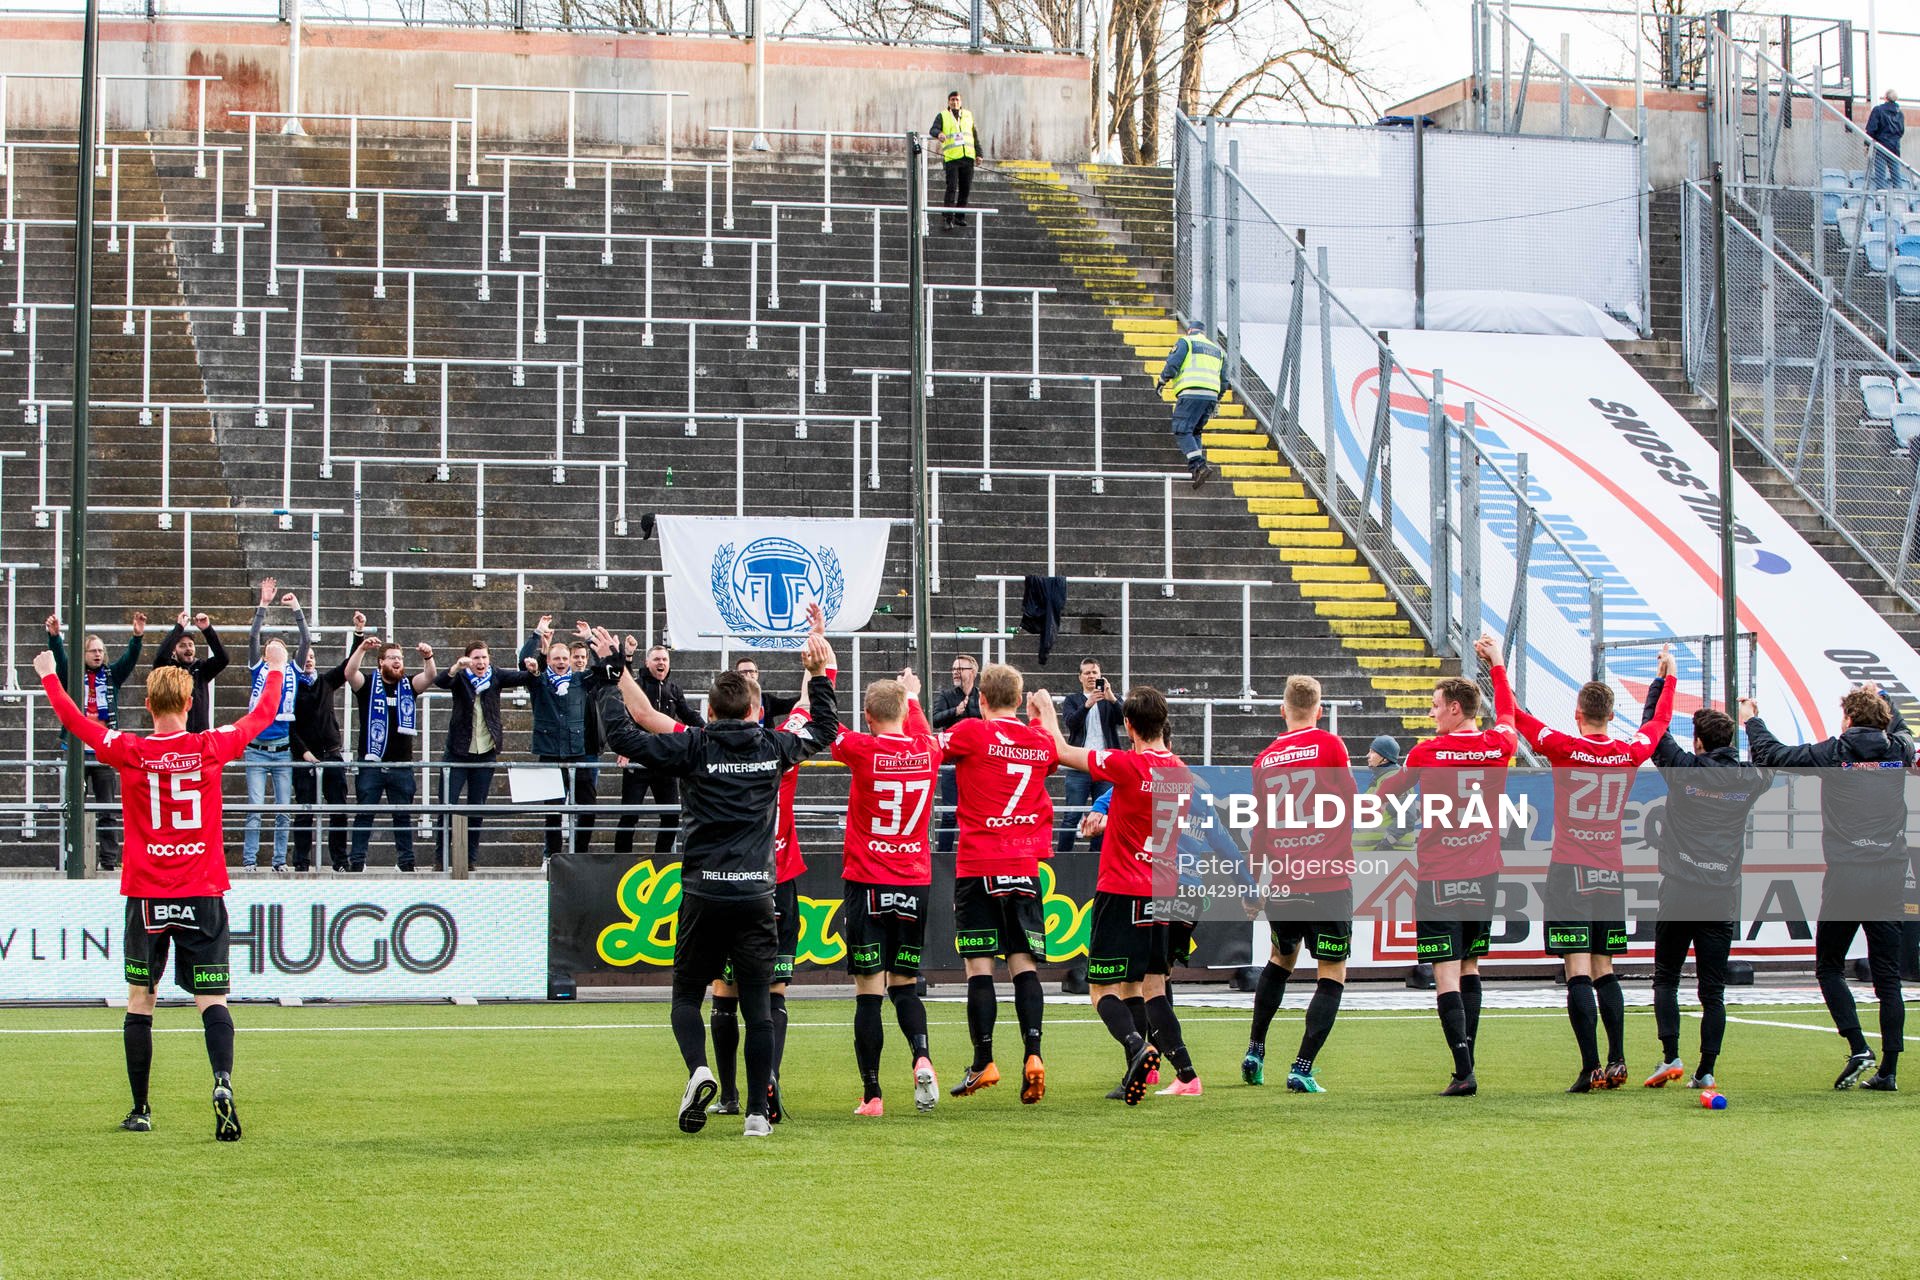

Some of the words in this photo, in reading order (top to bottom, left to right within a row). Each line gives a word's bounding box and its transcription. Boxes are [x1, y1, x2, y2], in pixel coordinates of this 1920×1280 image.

[987, 743, 1050, 762] ERIKSBERG
[1435, 748, 1502, 761] smarteyes
[1570, 750, 1596, 764] AROS
[1596, 753, 1633, 765] KAPITAL
[718, 760, 780, 773] INTERSPORT
[1002, 763, 1033, 817] 7
[1568, 770, 1628, 821] 20
[147, 771, 203, 831] 15
[871, 779, 931, 836] 37
[1143, 800, 1179, 854] 3
[701, 870, 762, 881] TRELLEBORGS
[1586, 869, 1620, 884] BCA
[1443, 881, 1482, 897] BCA
[880, 892, 917, 911] BCA
[153, 904, 196, 921] BCA
[228, 903, 459, 975] HUGO
[958, 935, 984, 947] akea
[1551, 932, 1577, 943] akea
[1318, 939, 1343, 952] akea
[126, 963, 149, 976] akea
[774, 961, 793, 972] kea
[1090, 963, 1115, 974] akea
[195, 970, 224, 983] akea
